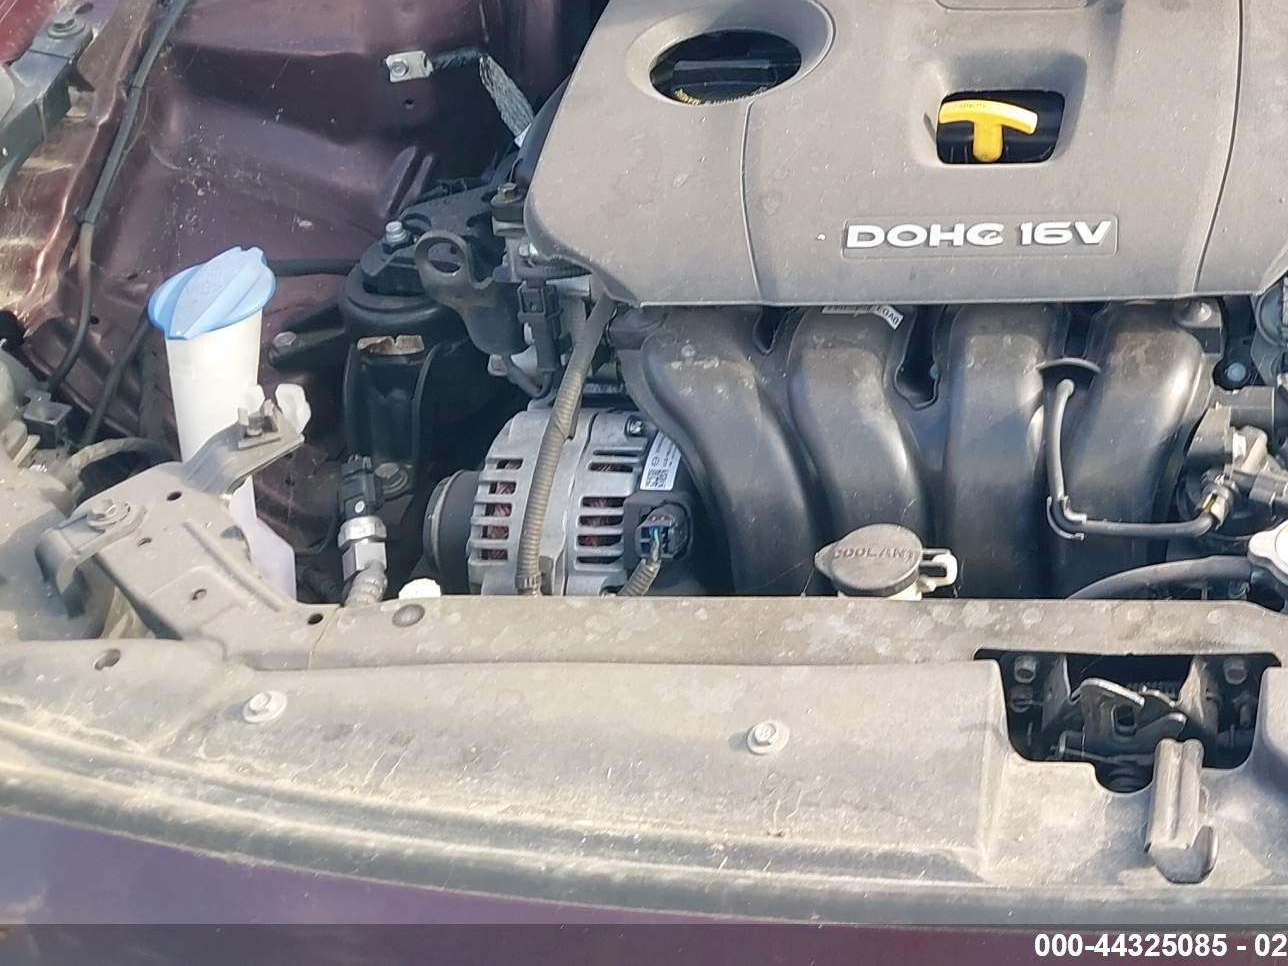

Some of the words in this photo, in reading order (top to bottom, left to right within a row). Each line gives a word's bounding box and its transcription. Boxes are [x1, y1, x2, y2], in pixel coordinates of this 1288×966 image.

[846, 222, 1004, 248] DOHC
[1020, 221, 1112, 245] 16V
[832, 546, 914, 560] COOLANT
